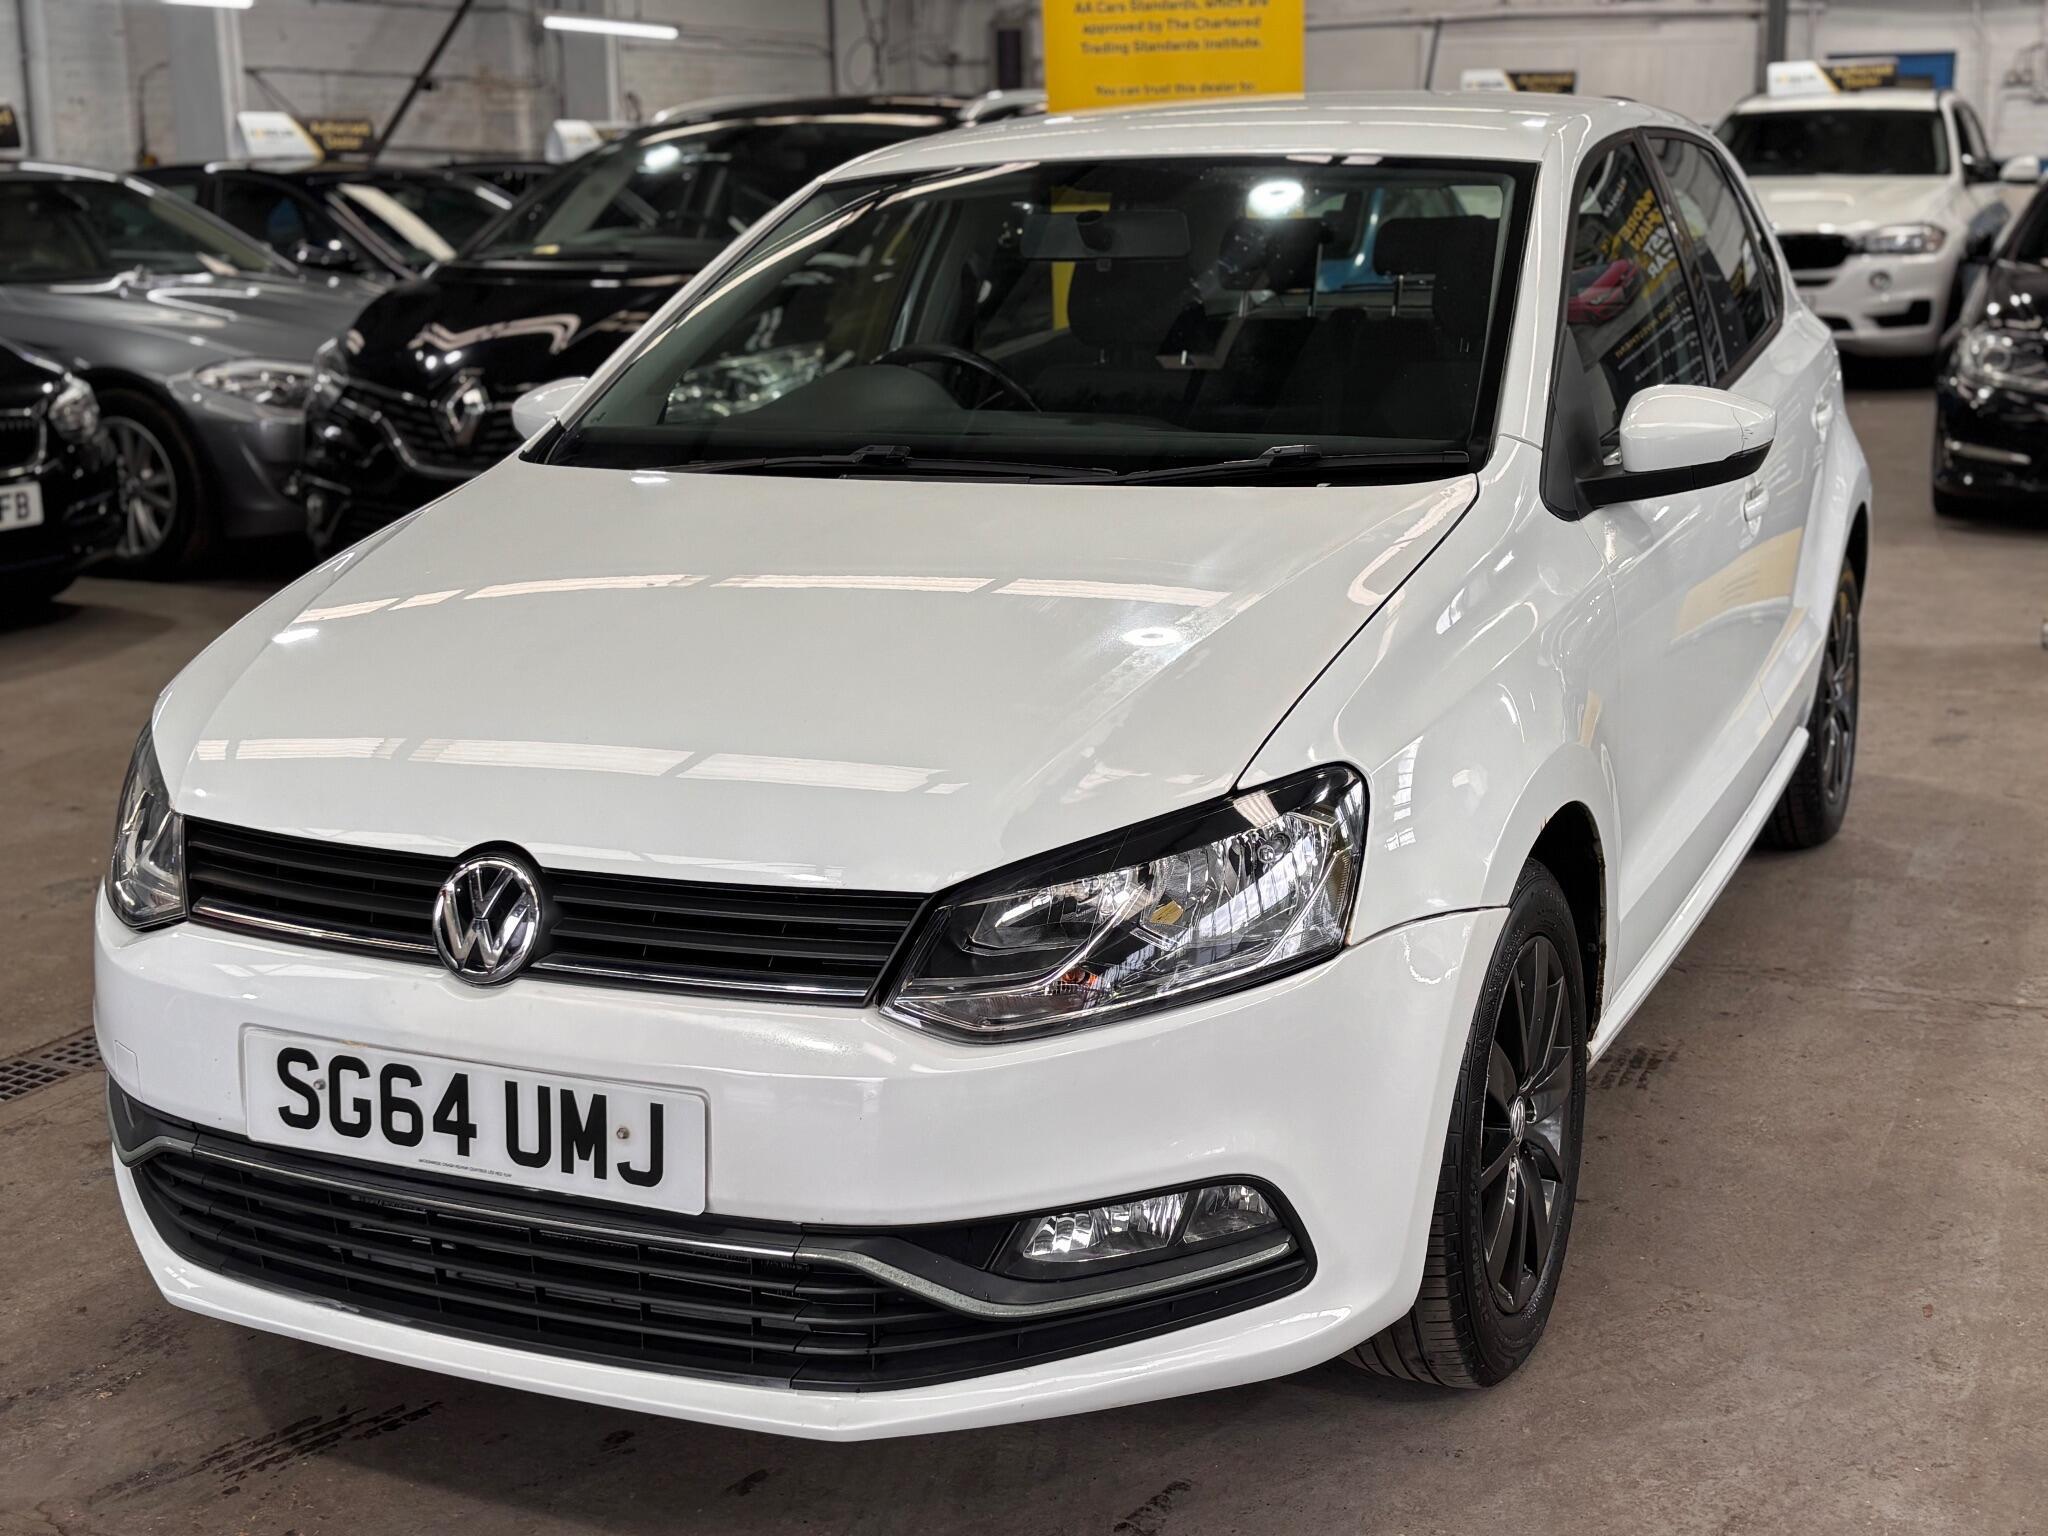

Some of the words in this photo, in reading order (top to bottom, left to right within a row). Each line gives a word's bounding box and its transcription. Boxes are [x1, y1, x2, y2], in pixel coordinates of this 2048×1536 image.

[1075, 2, 1092, 13] AA
[1096, 1, 1125, 13] Cars
[1083, 21, 1144, 35] approved
[1147, 20, 1162, 33] by
[1166, 18, 1189, 29] The
[1195, 16, 1261, 29] Chartered
[1080, 41, 1130, 54] Trading
[1134, 39, 1200, 51] Standards
[1095, 85, 1115, 96] You
[1143, 84, 1170, 95] trust
[1174, 82, 1197, 93] this
[1201, 81, 1237, 92] dealer
[277, 1047, 477, 1157] SG64
[505, 1080, 664, 1188] UMJ
